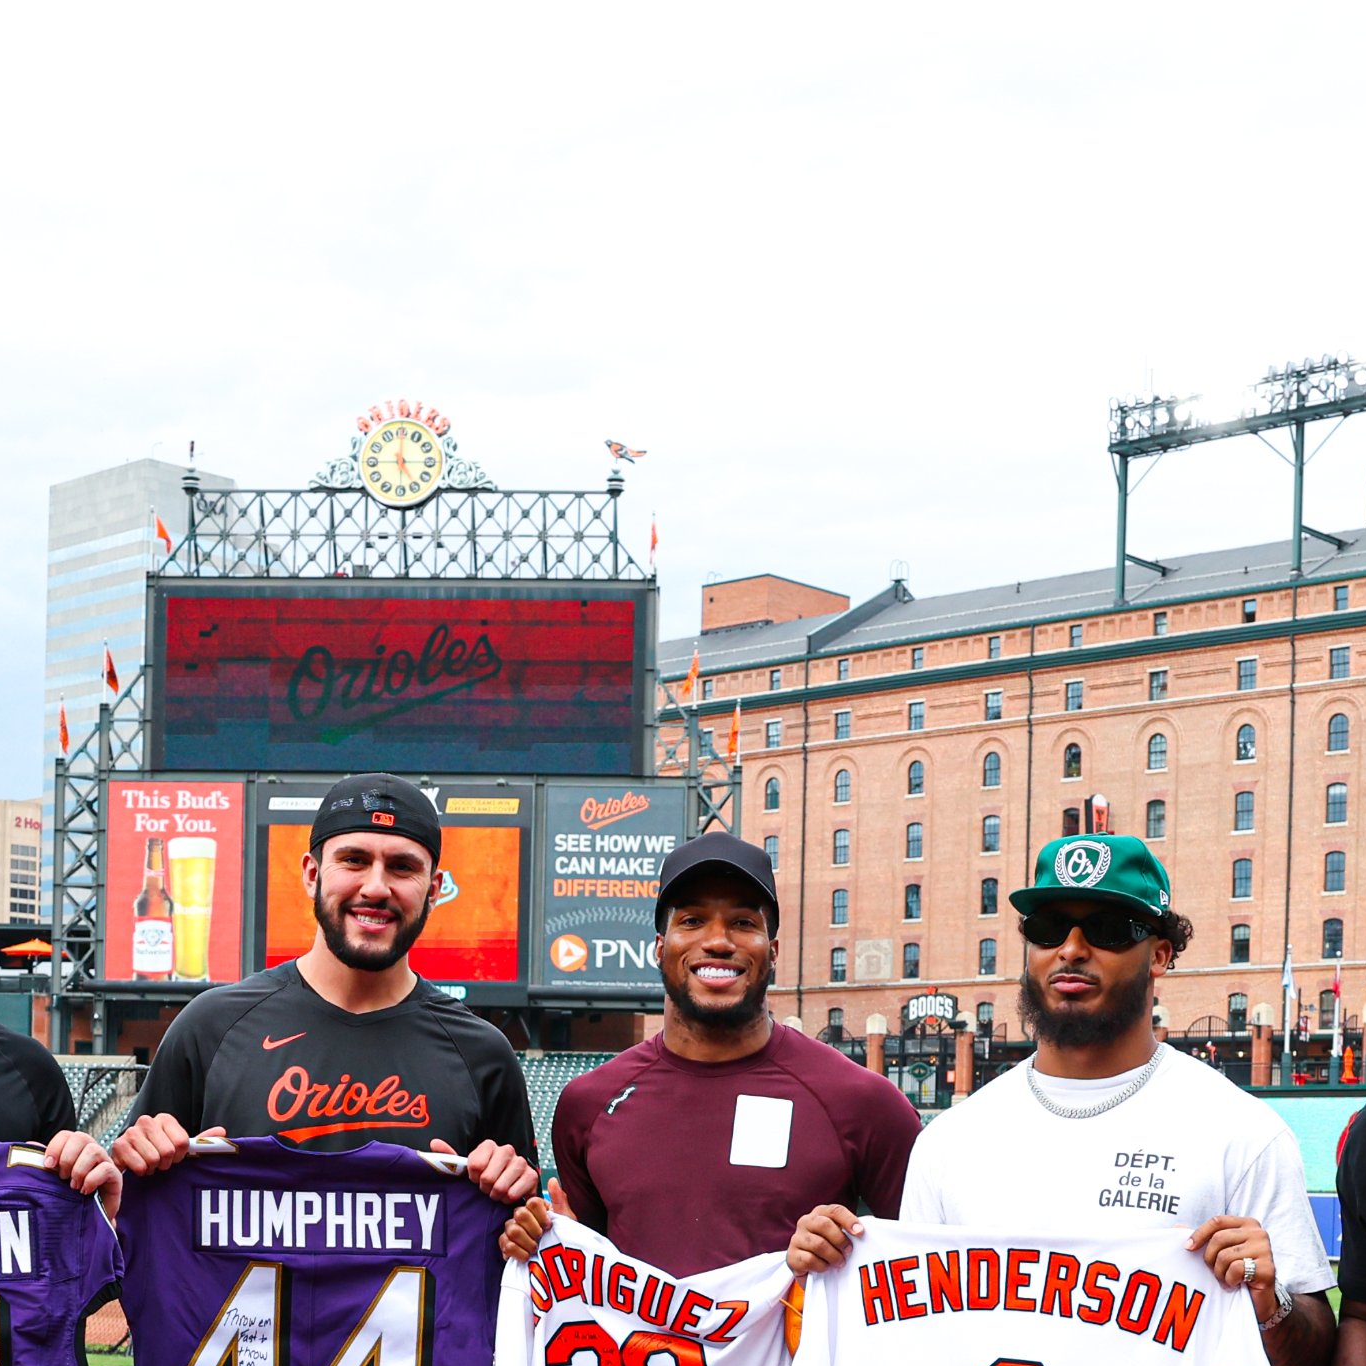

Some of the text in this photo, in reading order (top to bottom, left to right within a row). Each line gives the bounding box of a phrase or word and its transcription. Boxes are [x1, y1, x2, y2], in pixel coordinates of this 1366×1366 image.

[357, 399, 451, 437] ORIOLES
[288, 623, 503, 745] Orioles
[122, 790, 230, 810] This Bud's
[580, 791, 650, 830] Orioles
[135, 814, 217, 833] For You.
[555, 834, 676, 854] SEE HOW WE
[555, 857, 595, 875] CAN
[599, 858, 655, 876] MAKE
[553, 878, 661, 898] DIFFERENC
[909, 995, 953, 1020] BOOG'S
[266, 1065, 430, 1143] Orioles
[1114, 1149, 1176, 1172] DÉPT.
[1118, 1173, 1165, 1190] de la
[1098, 1188, 1181, 1215] GALERIE
[200, 1189, 440, 1250] HUMPHREY
[529, 1243, 749, 1342] ODRIGUEZ
[859, 1248, 1205, 1352] HENDERSON
[223, 1308, 272, 1327] Throw em
[238, 1347, 268, 1360] throw
